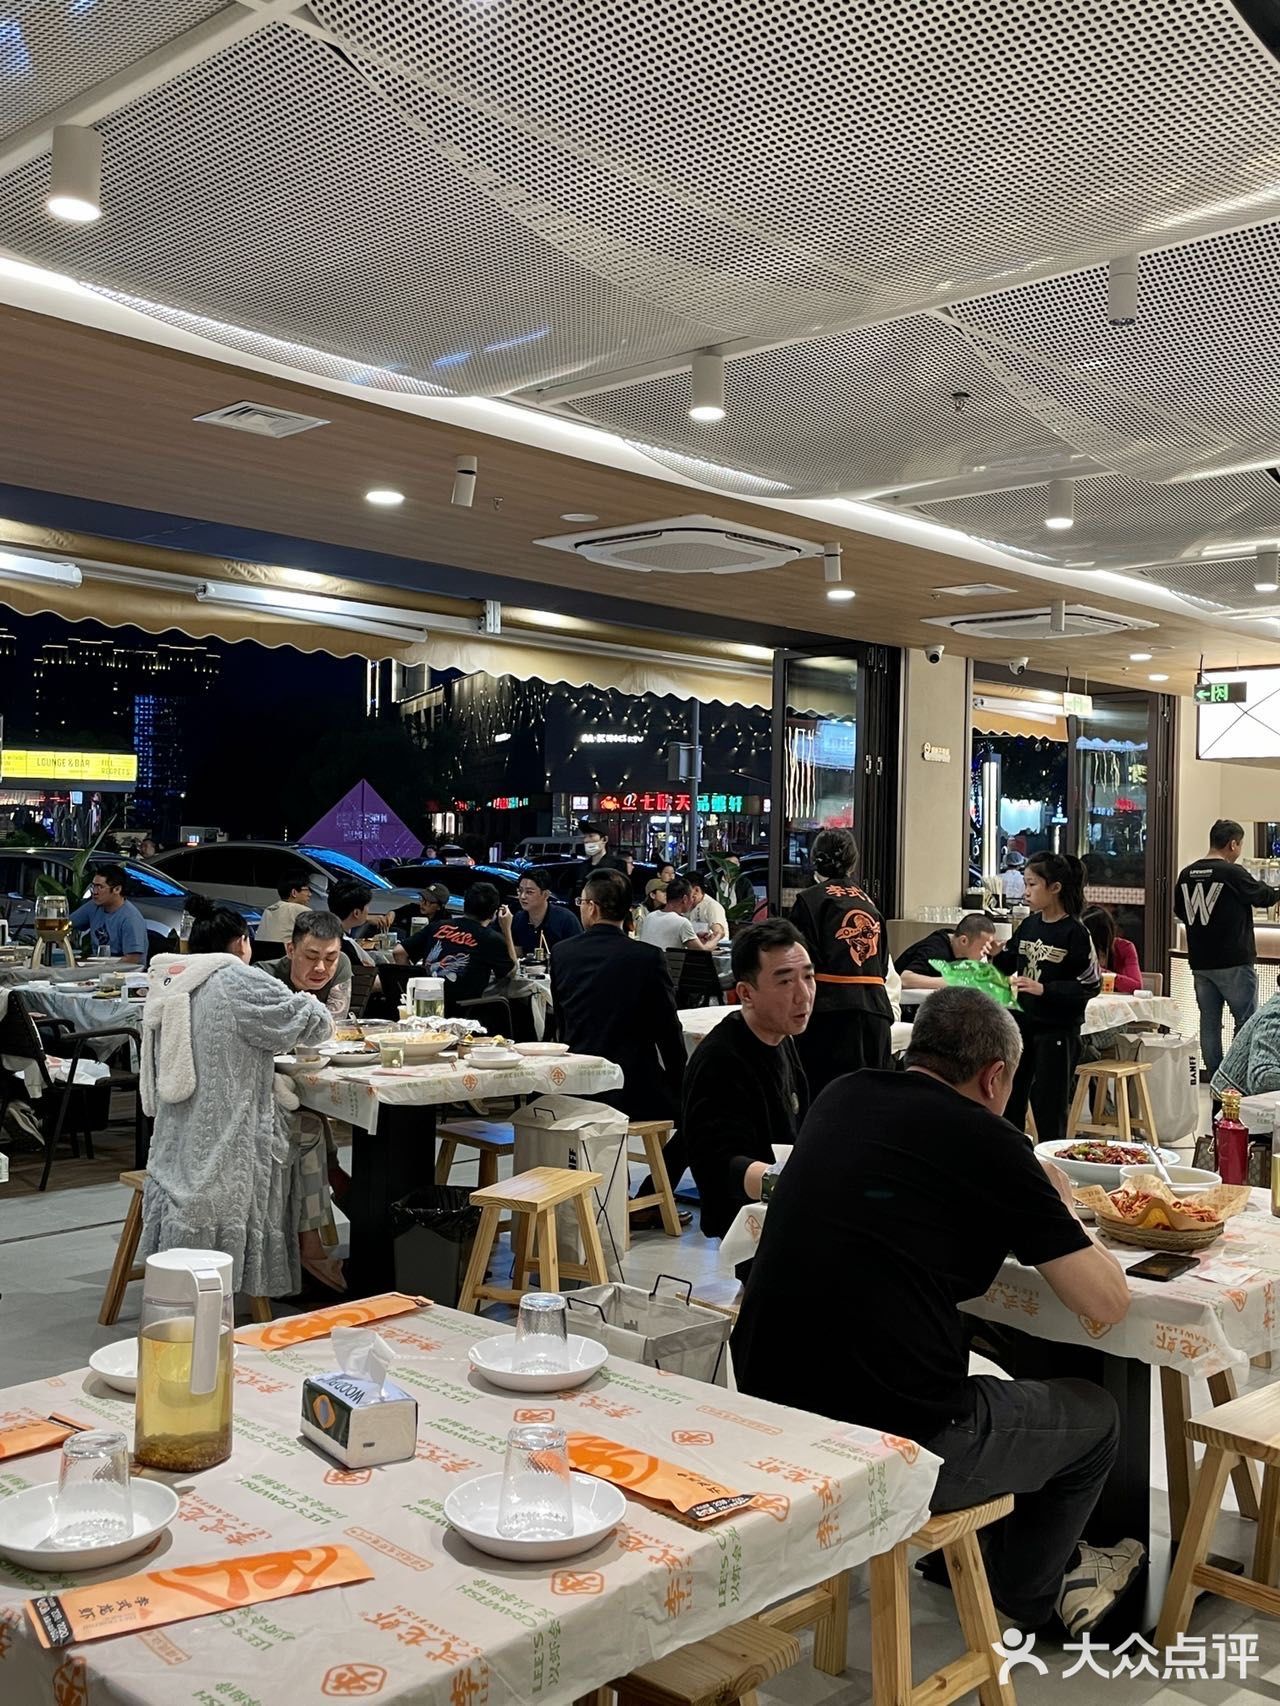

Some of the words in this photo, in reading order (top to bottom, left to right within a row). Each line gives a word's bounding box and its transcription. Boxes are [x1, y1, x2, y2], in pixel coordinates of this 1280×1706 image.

[639, 793, 691, 811] 七欣天
[1189, 1056, 1197, 1085] BANFF
